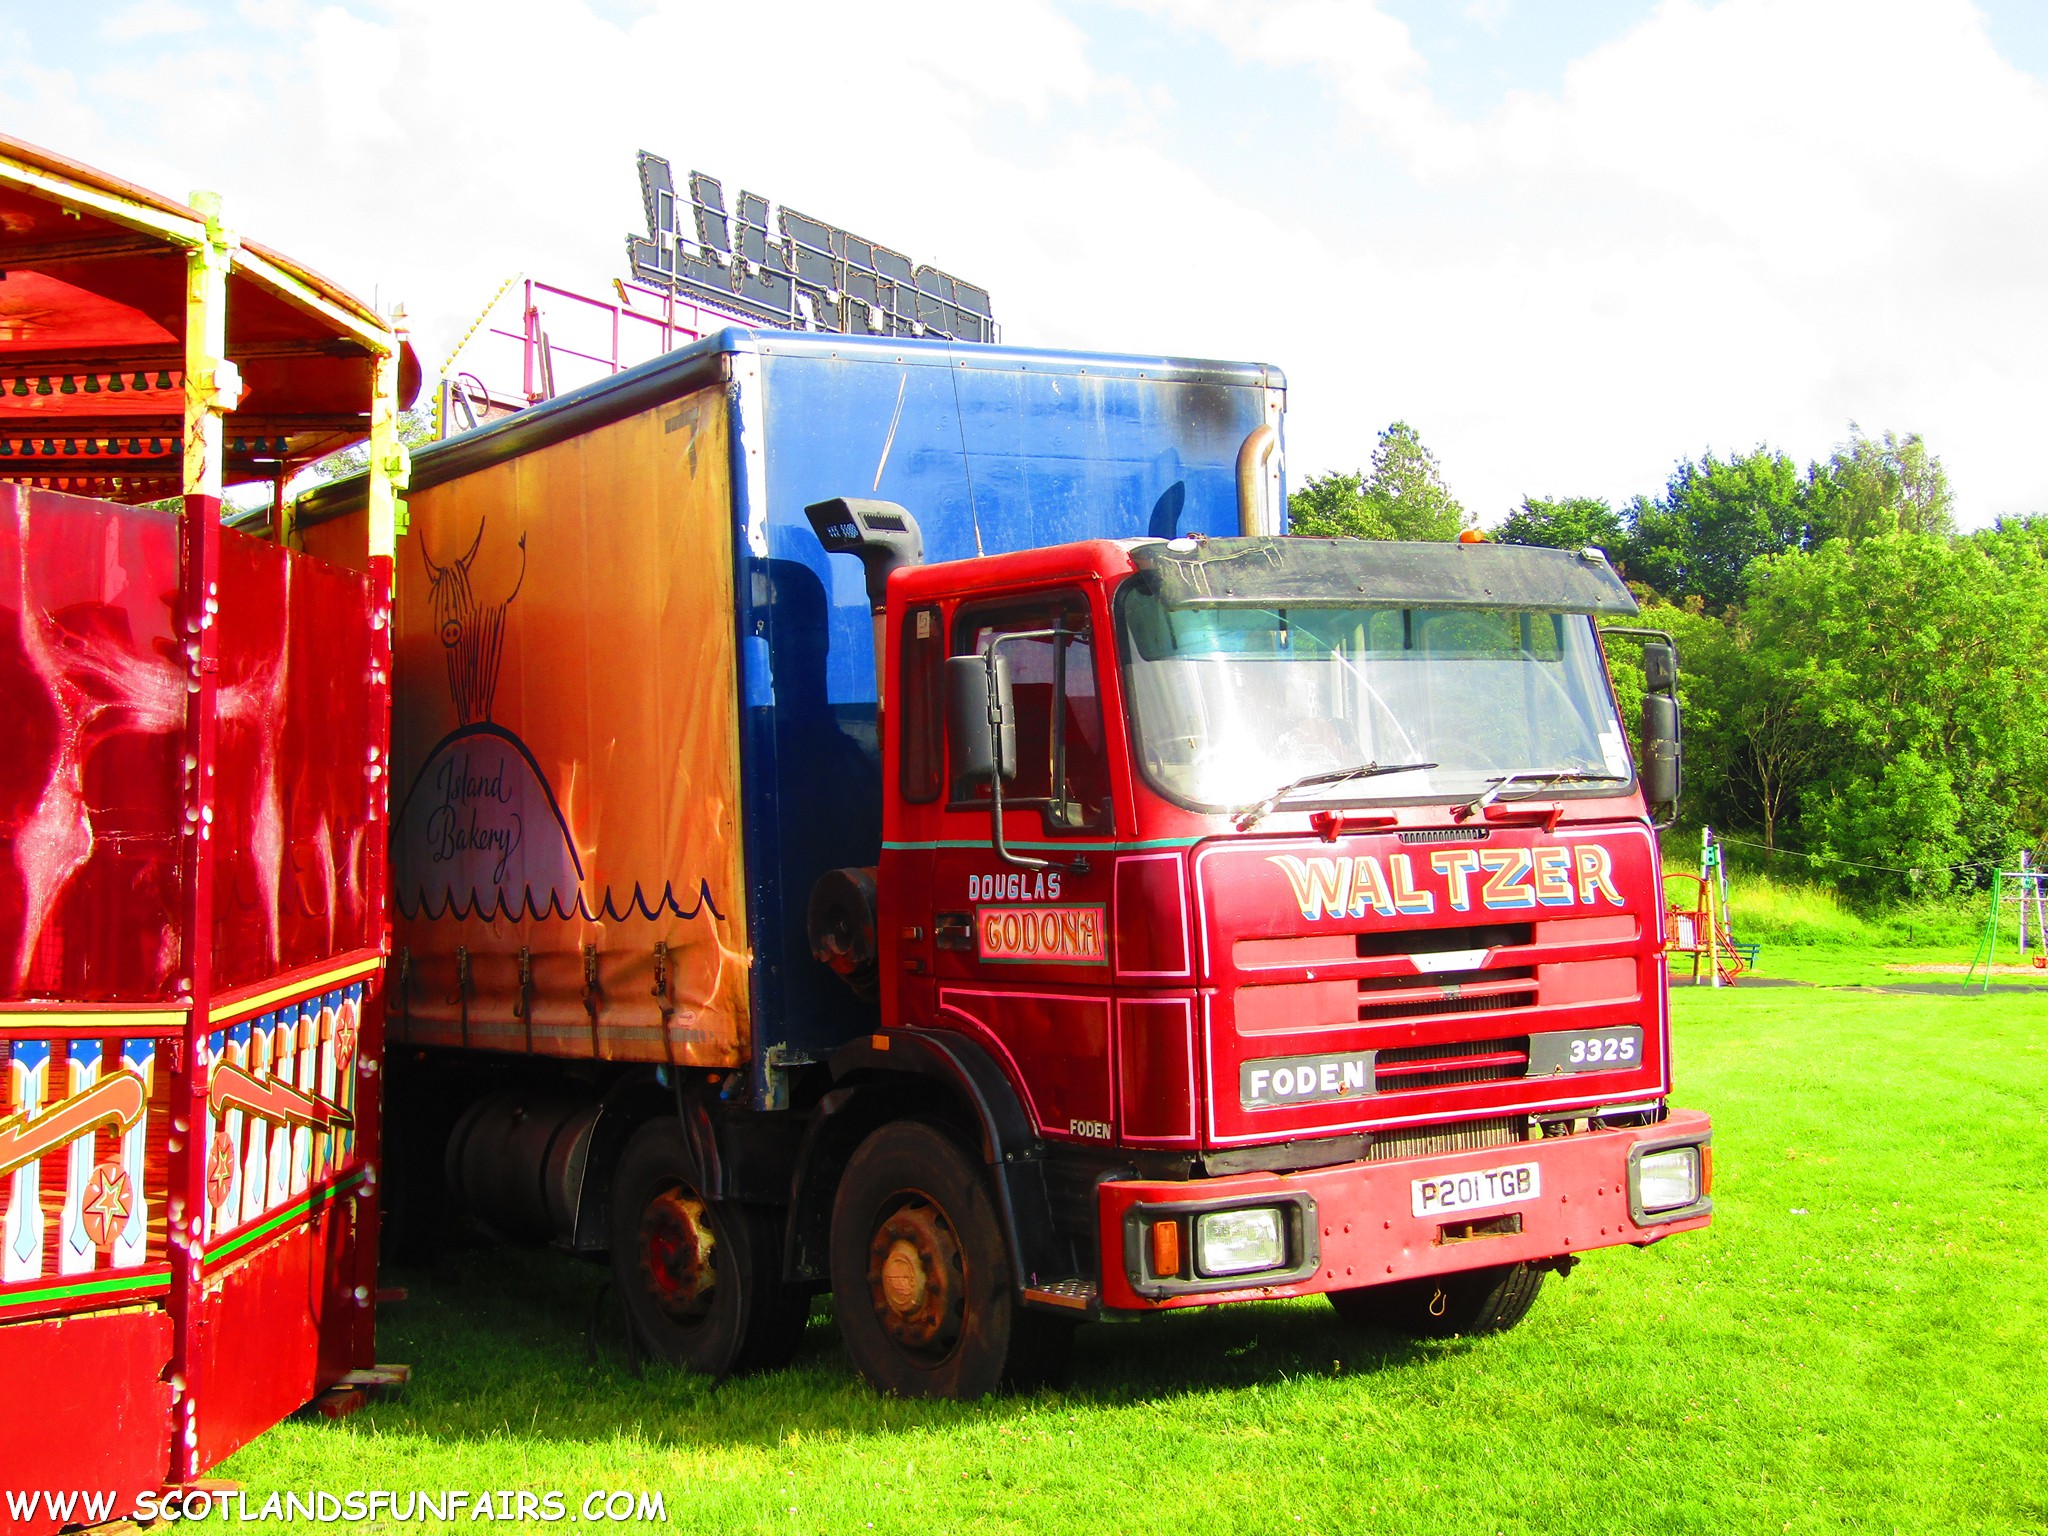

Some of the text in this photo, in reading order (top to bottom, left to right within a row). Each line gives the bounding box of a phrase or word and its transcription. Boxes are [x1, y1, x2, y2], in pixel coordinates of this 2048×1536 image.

[437, 754, 512, 811] Island
[427, 805, 522, 884] Bakery
[969, 873, 1061, 901] DOUGLAS
[1265, 844, 1625, 921] WALTZER
[985, 910, 1101, 955] GODONA
[1569, 1035, 1636, 1064] 3325
[1250, 1060, 1365, 1099] FODEN
[1069, 1119, 1112, 1140] FODEN
[1421, 1168, 1531, 1209] P201 TGB
